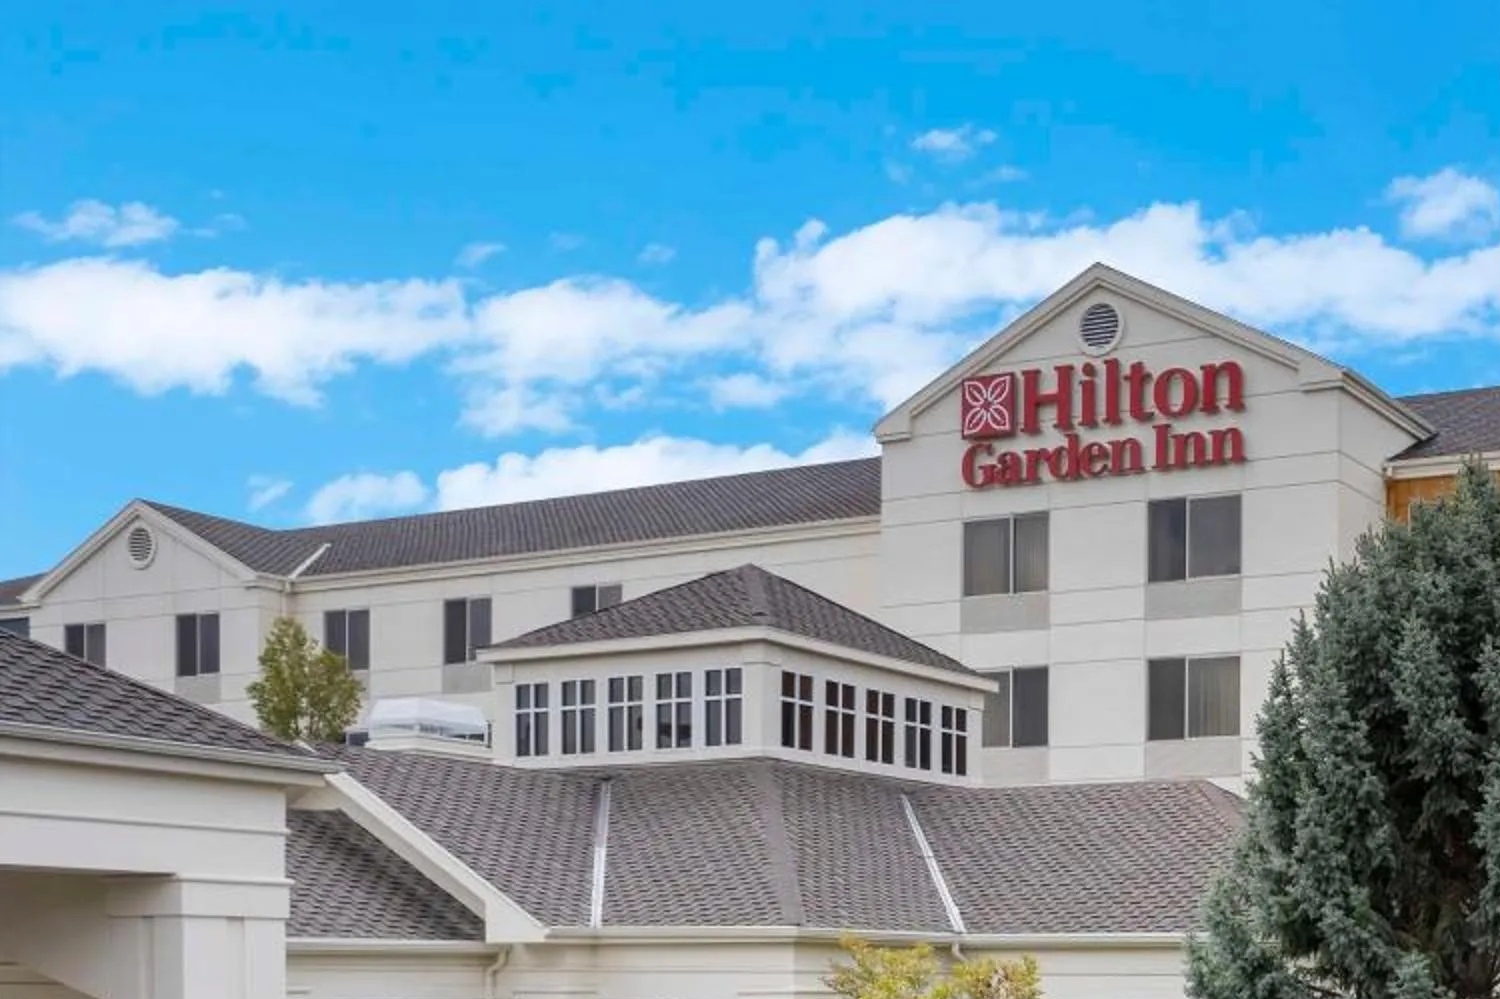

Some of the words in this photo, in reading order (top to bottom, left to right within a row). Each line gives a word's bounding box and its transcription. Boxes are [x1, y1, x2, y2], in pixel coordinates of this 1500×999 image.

[1021, 358, 1245, 434] Hilton
[961, 432, 1146, 490] Garden
[1151, 423, 1247, 472] Inn
